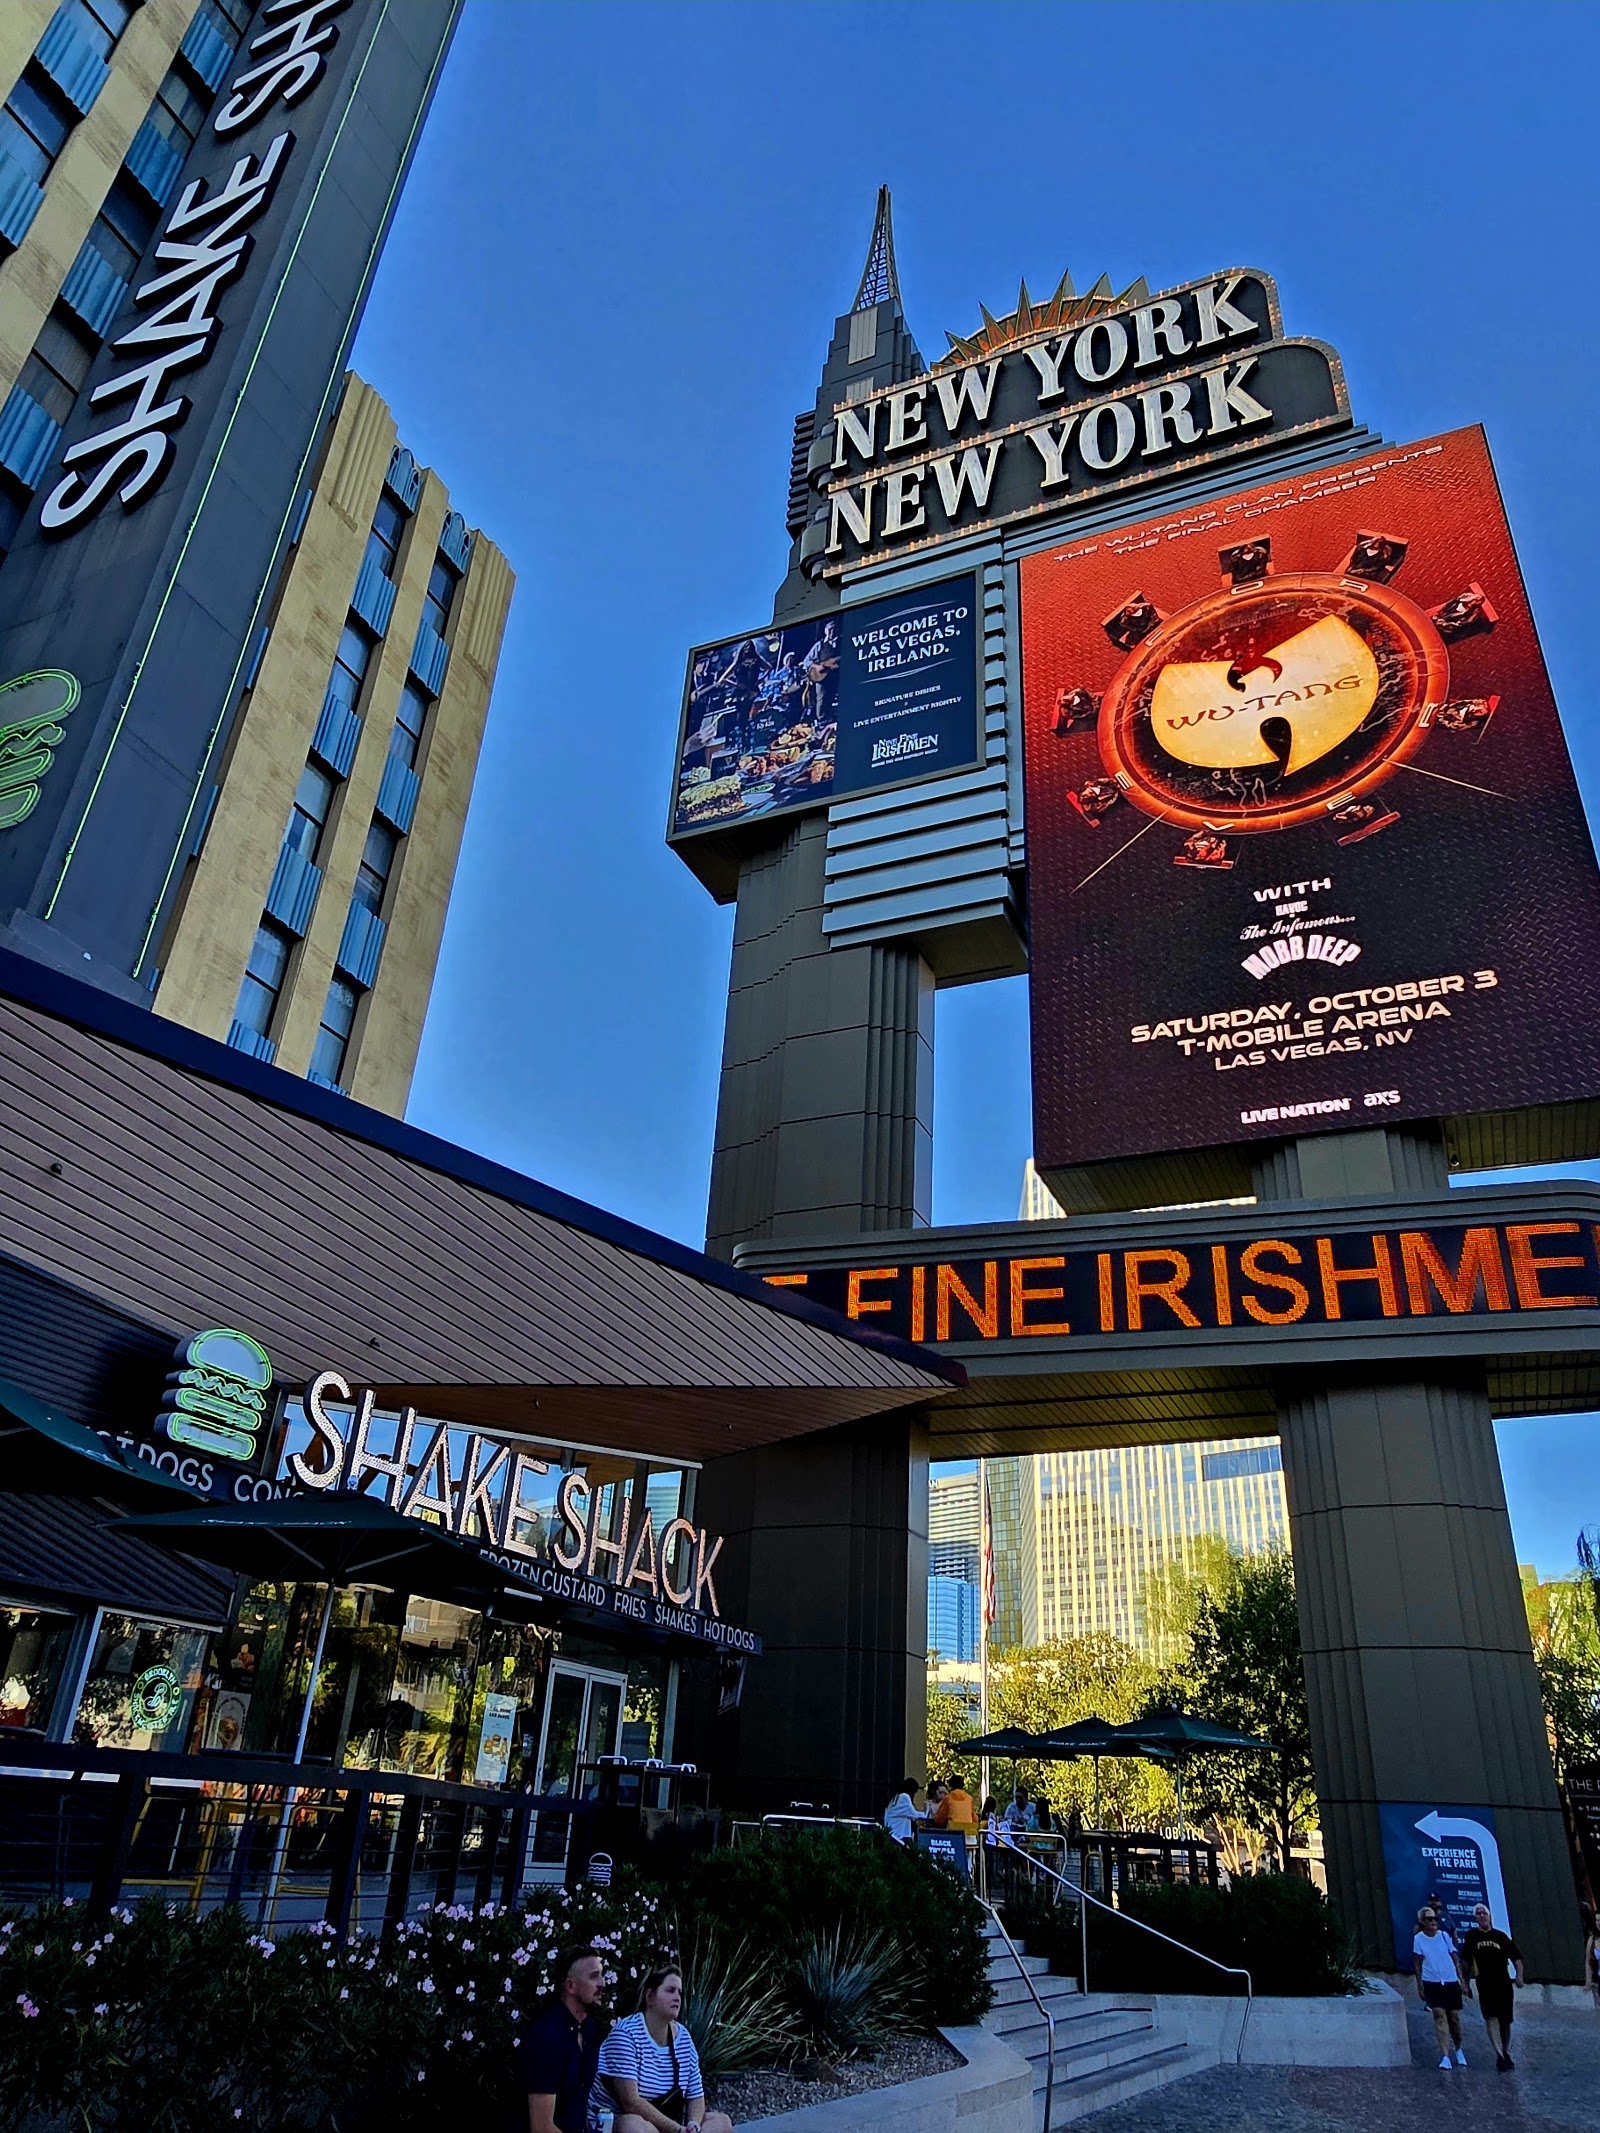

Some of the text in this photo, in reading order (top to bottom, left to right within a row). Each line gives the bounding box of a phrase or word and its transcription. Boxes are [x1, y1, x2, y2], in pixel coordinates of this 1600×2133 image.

[40, 131, 289, 528] SHAKE
[831, 275, 1258, 469] NEW YORK
[825, 358, 1272, 553] NEW YORK
[1054, 445, 1443, 562] THE WU-TANG CLAN PRESENTS
[1113, 476, 1376, 555] THE FINAL CHAMBER
[851, 606, 968, 648] WELCOME TO
[858, 624, 961, 661] LAS VEGAS.
[868, 643, 950, 673] IRELAND.
[853, 696, 962, 728] LIVE ENTERTAINMENT NIGHTLY
[1166, 675, 1365, 731] WU-TANG
[871, 734, 939, 761] IRISHMEN
[1252, 877, 1332, 903] WITH
[1240, 924, 1267, 940] The
[1241, 934, 1362, 980] MOBB DEEP
[1131, 969, 1499, 1044] SATURDAY, OCTOBER 3
[1178, 1000, 1452, 1057] T-MOBILE ARENA
[1215, 1028, 1414, 1071] LAS VEGAS, NV
[1241, 1109, 1279, 1124] LIVE
[1280, 1098, 1351, 1119] NATION
[847, 1222, 1600, 1341] FINE IRISHME
[287, 1370, 725, 1617] SHAKE SHACK
[542, 1569, 606, 1606] CUSTARD
[614, 1591, 647, 1619] FRIES
[655, 1604, 697, 1634] SHAKES
[144, 1667, 178, 1685] BROOKLYN
[930, 1839, 952, 1847] BLACK
[1421, 1847, 1477, 1859] EXPERIENCE
[1434, 1858, 1478, 1869] THE PARK
